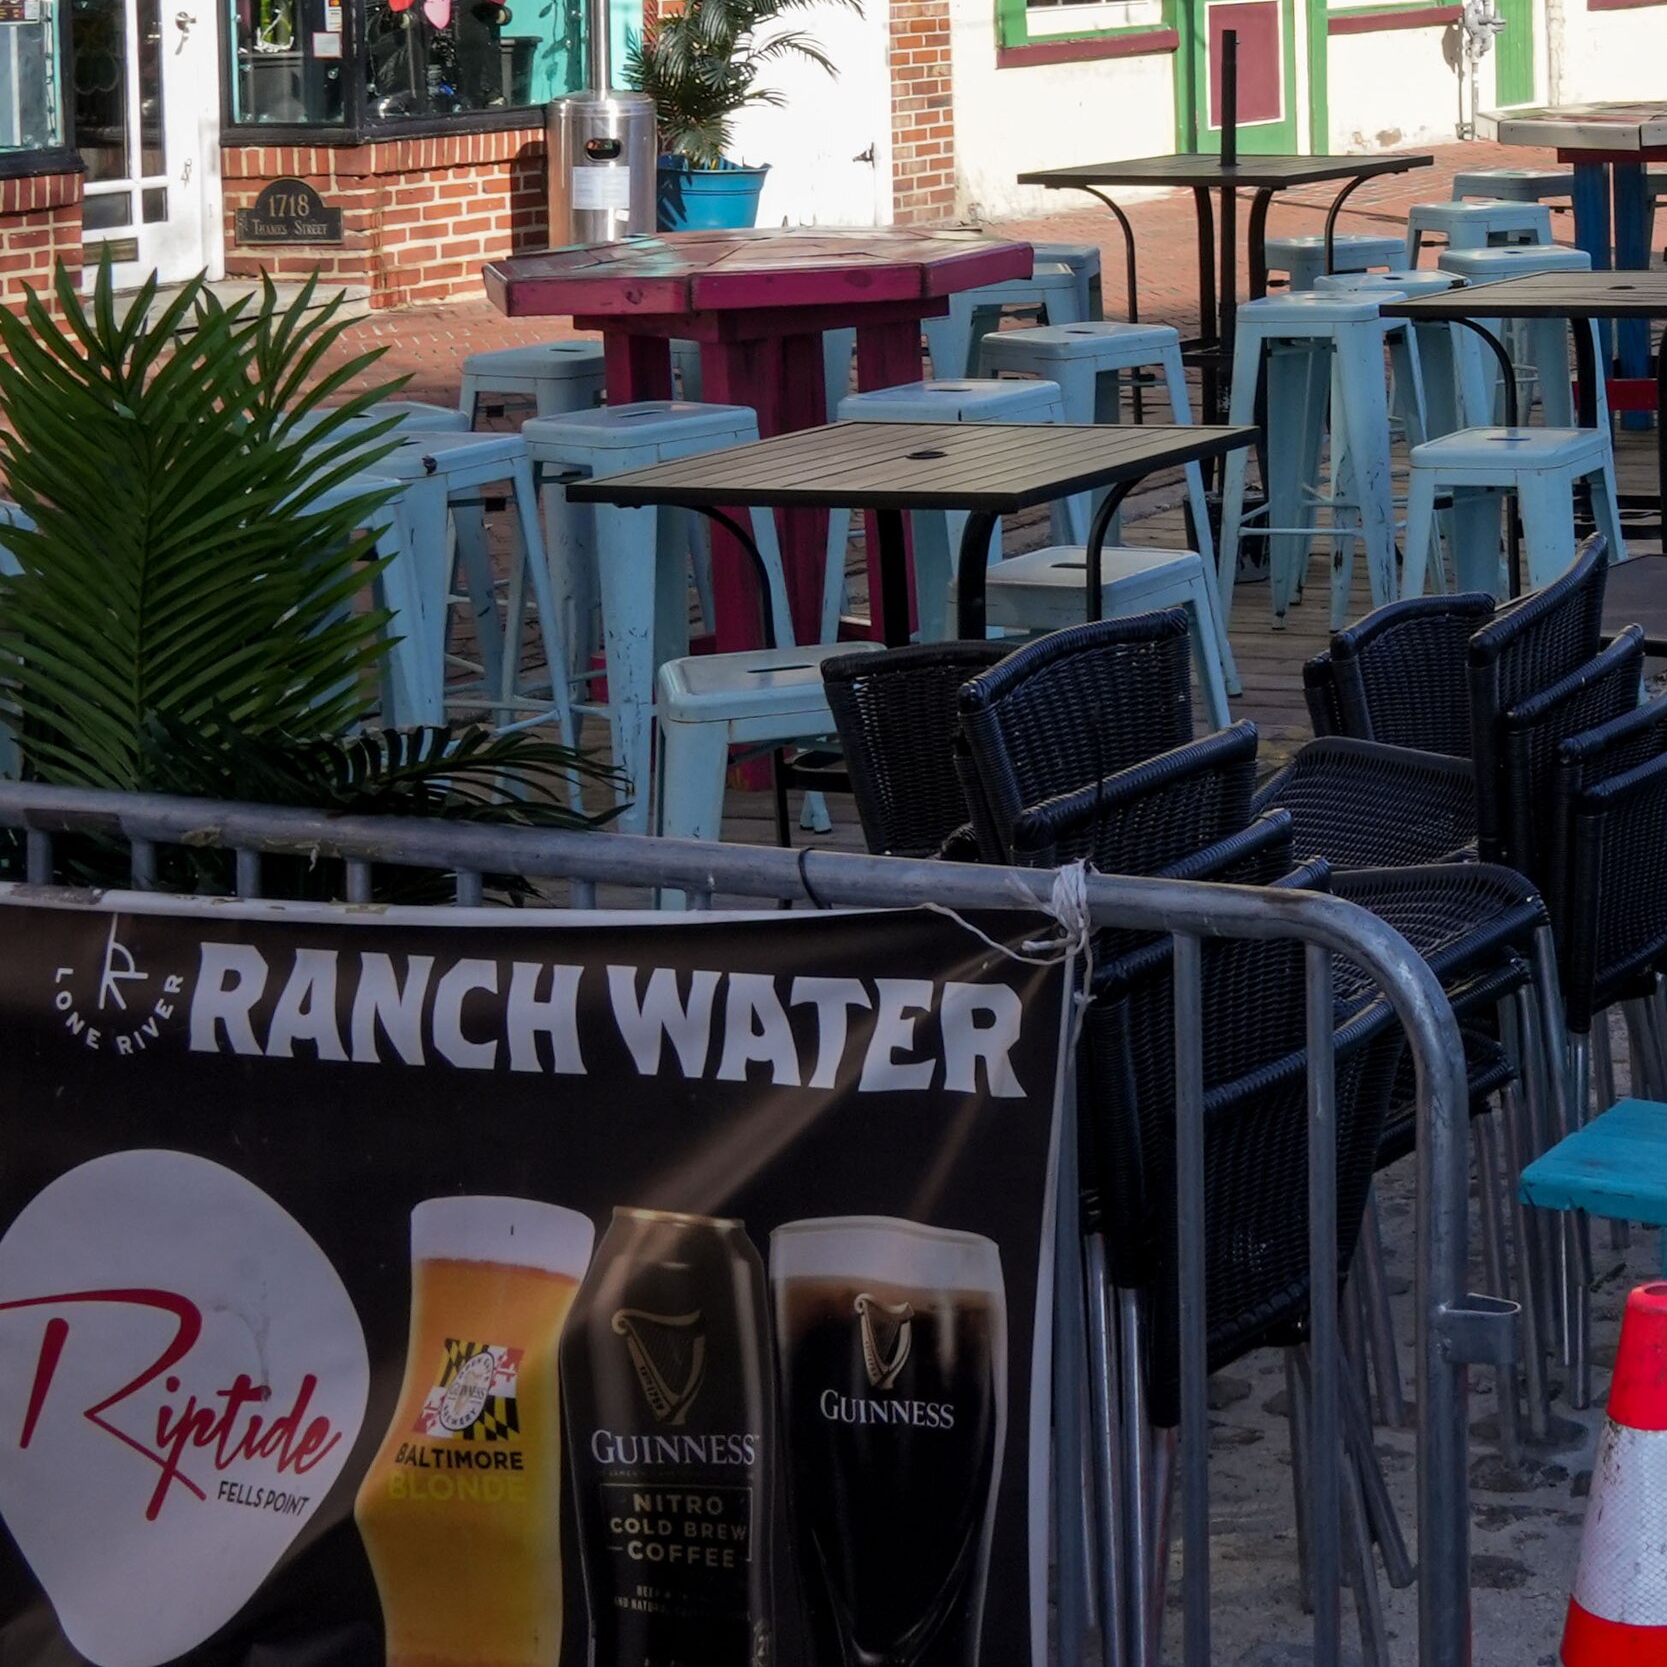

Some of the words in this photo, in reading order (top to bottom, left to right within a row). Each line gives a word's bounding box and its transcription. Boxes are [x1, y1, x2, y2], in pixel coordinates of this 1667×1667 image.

[269, 194, 310, 217] 1718
[55, 967, 101, 1049] LONE
[116, 974, 184, 1055] RIVER
[189, 941, 588, 1076] RANCH
[606, 964, 1026, 1099] WATER
[0, 1288, 342, 1521] Riptide
[820, 1388, 955, 1430] GUINNESS
[395, 1443, 524, 1470] BALTIMORE
[591, 1429, 756, 1465] GUINNESS
[218, 1480, 263, 1510] FELLS
[264, 1492, 310, 1516] POINT
[387, 1471, 528, 1502] BLONDE
[633, 1493, 723, 1516] NITRO
[609, 1517, 673, 1535] COLD
[684, 1521, 747, 1540] BREW
[627, 1540, 735, 1568] COFFEE
